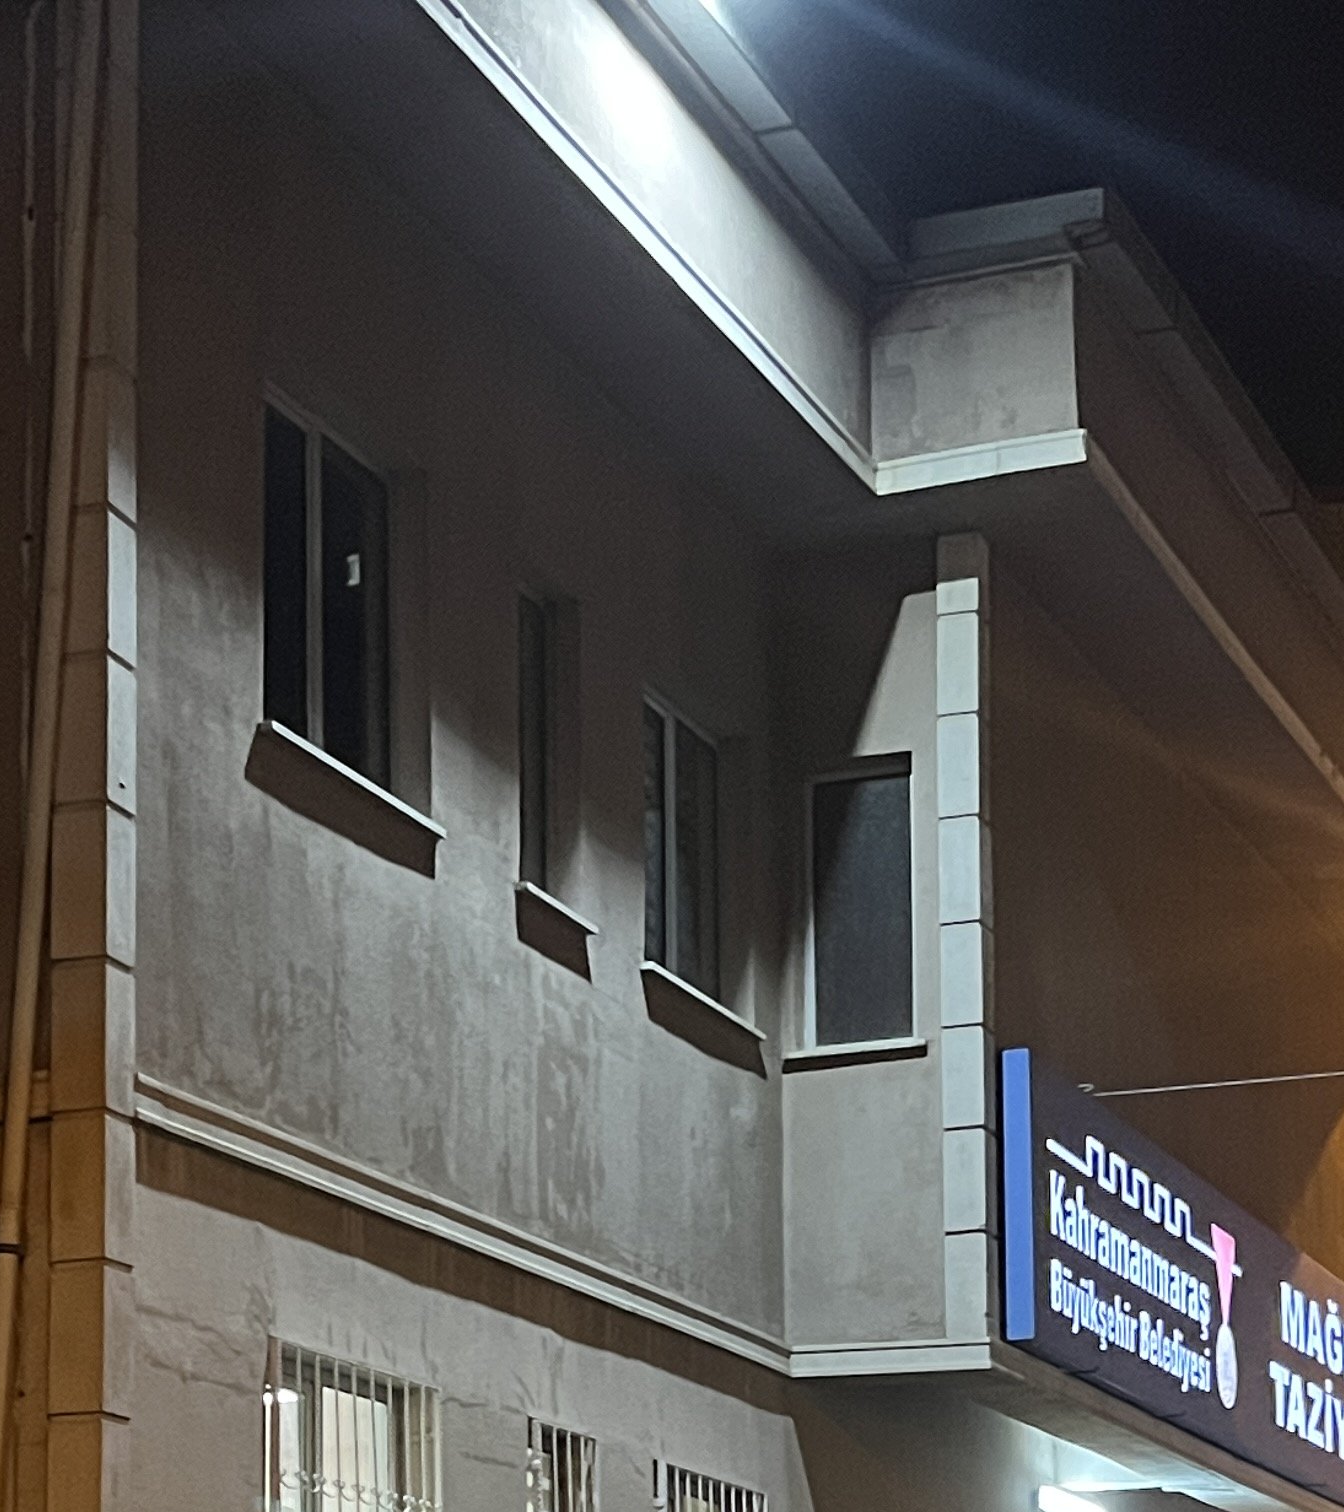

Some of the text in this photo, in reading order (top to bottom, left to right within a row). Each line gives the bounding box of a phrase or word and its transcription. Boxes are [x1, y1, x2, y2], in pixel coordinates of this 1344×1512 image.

[1049, 1169, 1211, 1341] Kahramanmaraş
[1050, 1258, 1211, 1393] Büyükşehir Belediyesi
